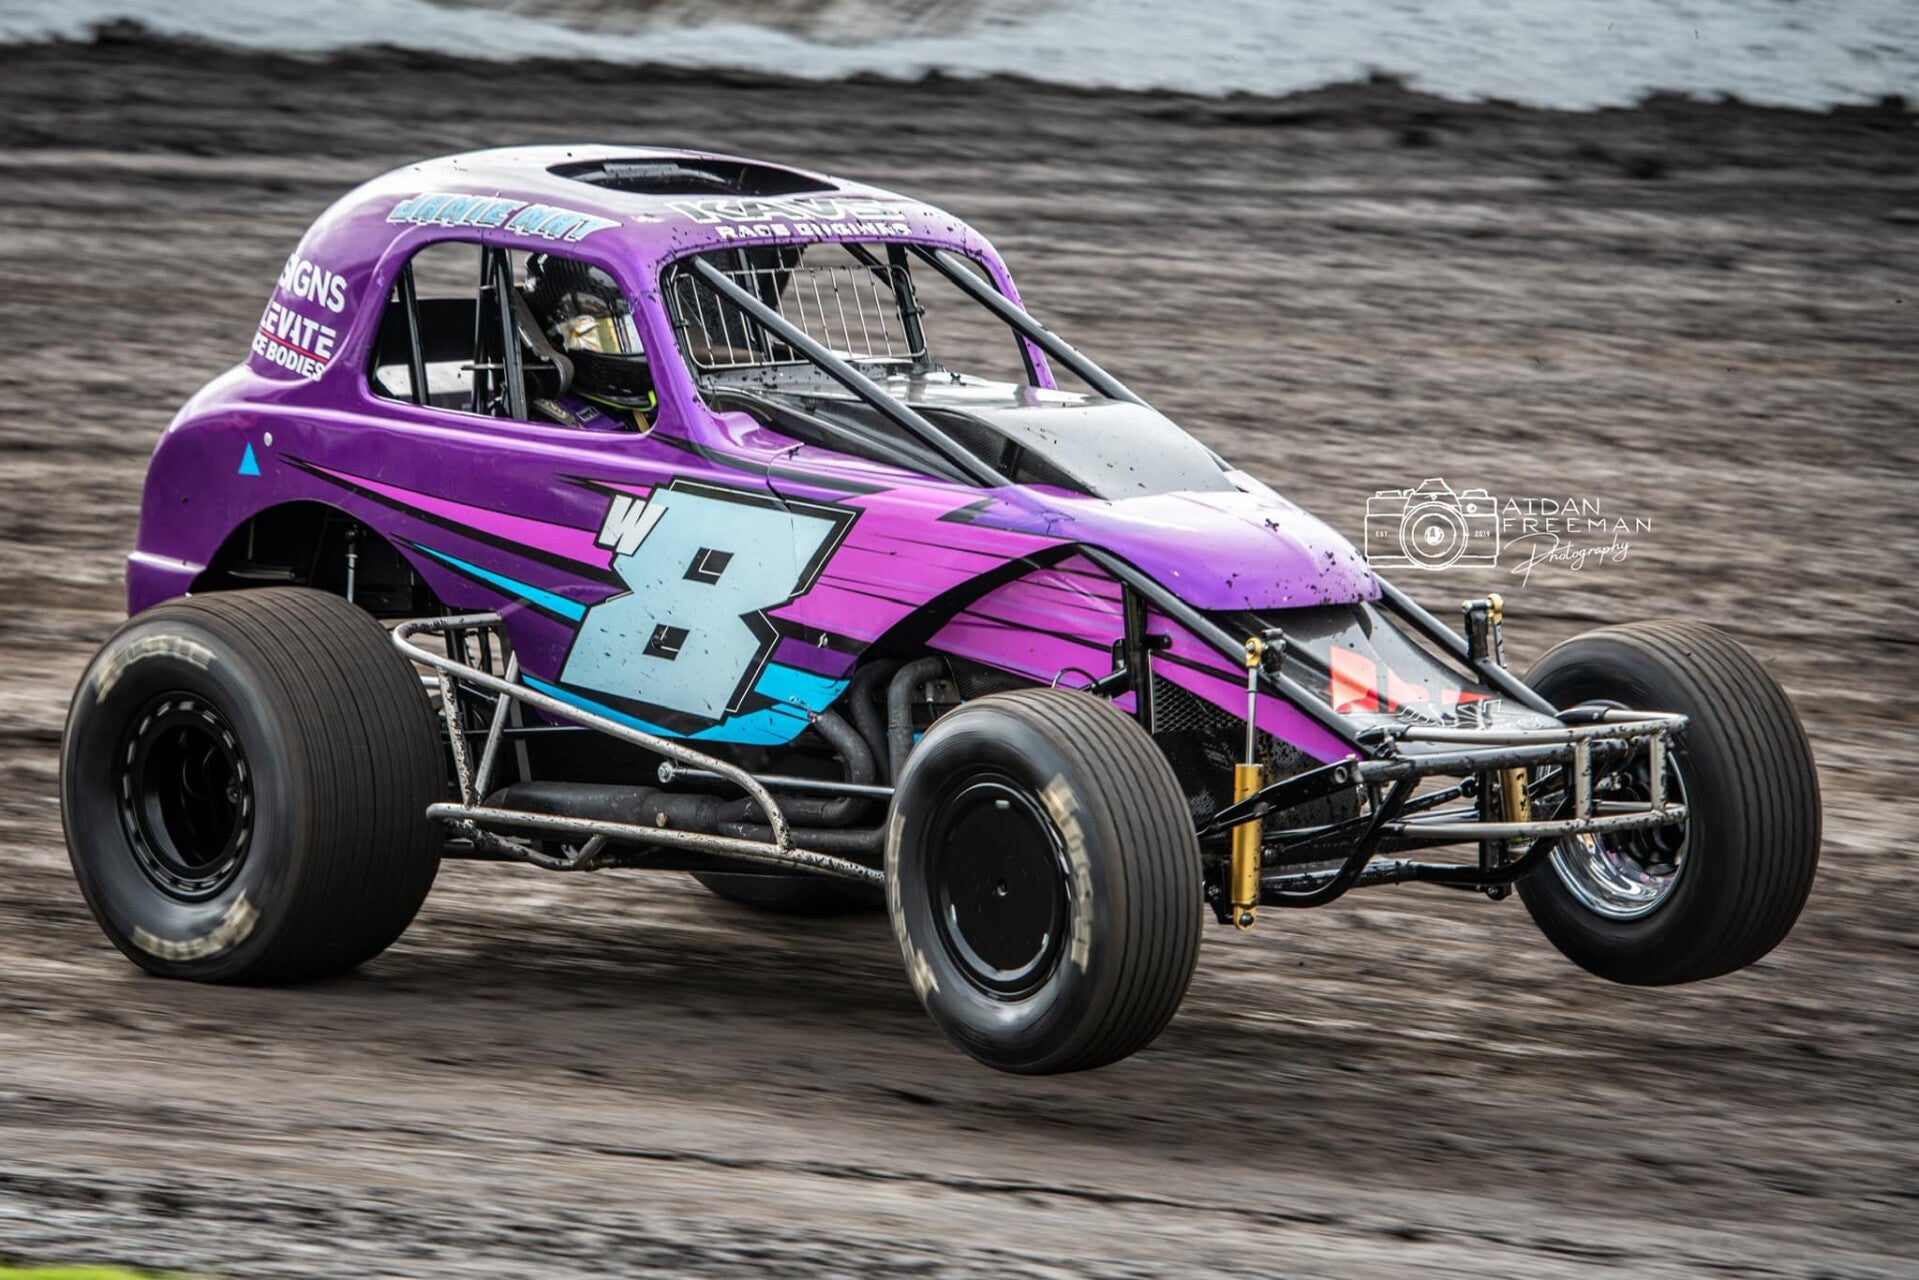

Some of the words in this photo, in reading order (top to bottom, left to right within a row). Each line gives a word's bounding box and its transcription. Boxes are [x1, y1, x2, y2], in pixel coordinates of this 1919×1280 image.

[714, 222, 791, 239] RACE
[793, 223, 912, 237] ENGINES
[266, 339, 326, 382] BODIES
